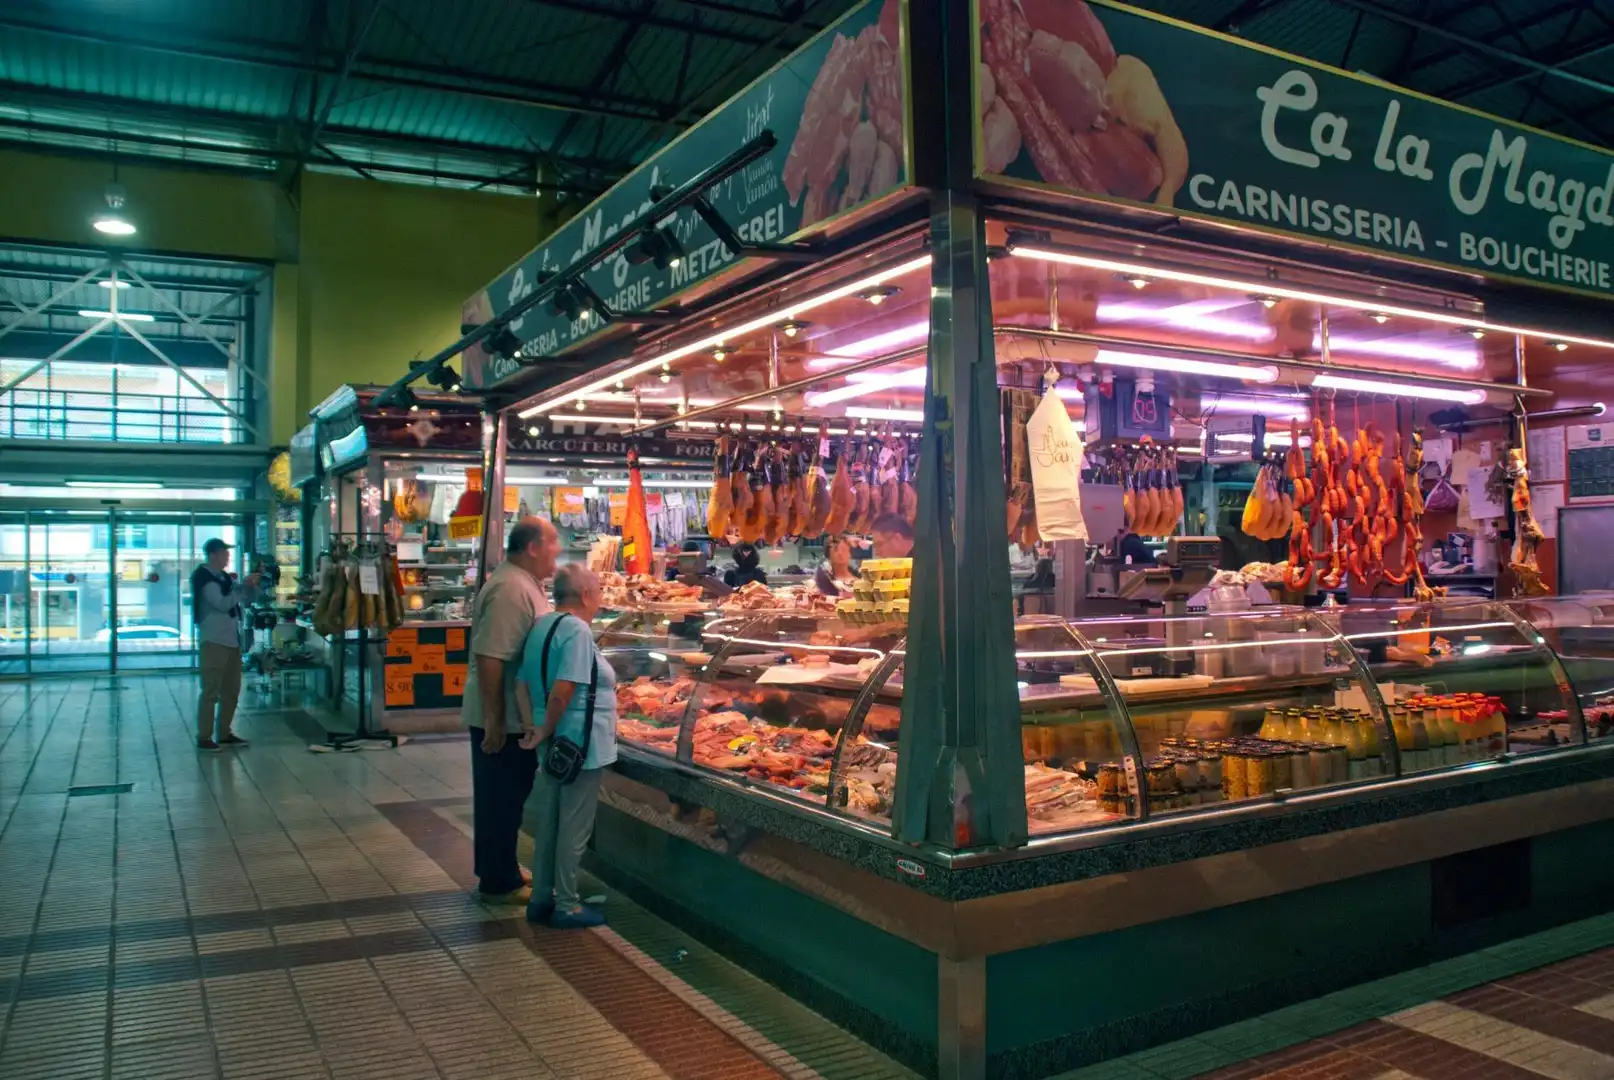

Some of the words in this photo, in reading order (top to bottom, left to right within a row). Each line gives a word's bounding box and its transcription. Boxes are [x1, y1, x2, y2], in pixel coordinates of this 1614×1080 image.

[1256, 70, 1352, 168] Ca
[1373, 99, 1434, 181] la
[1189, 173, 1426, 251] CARNISSERIA
[1460, 231, 1611, 289] BOUCHERIE
